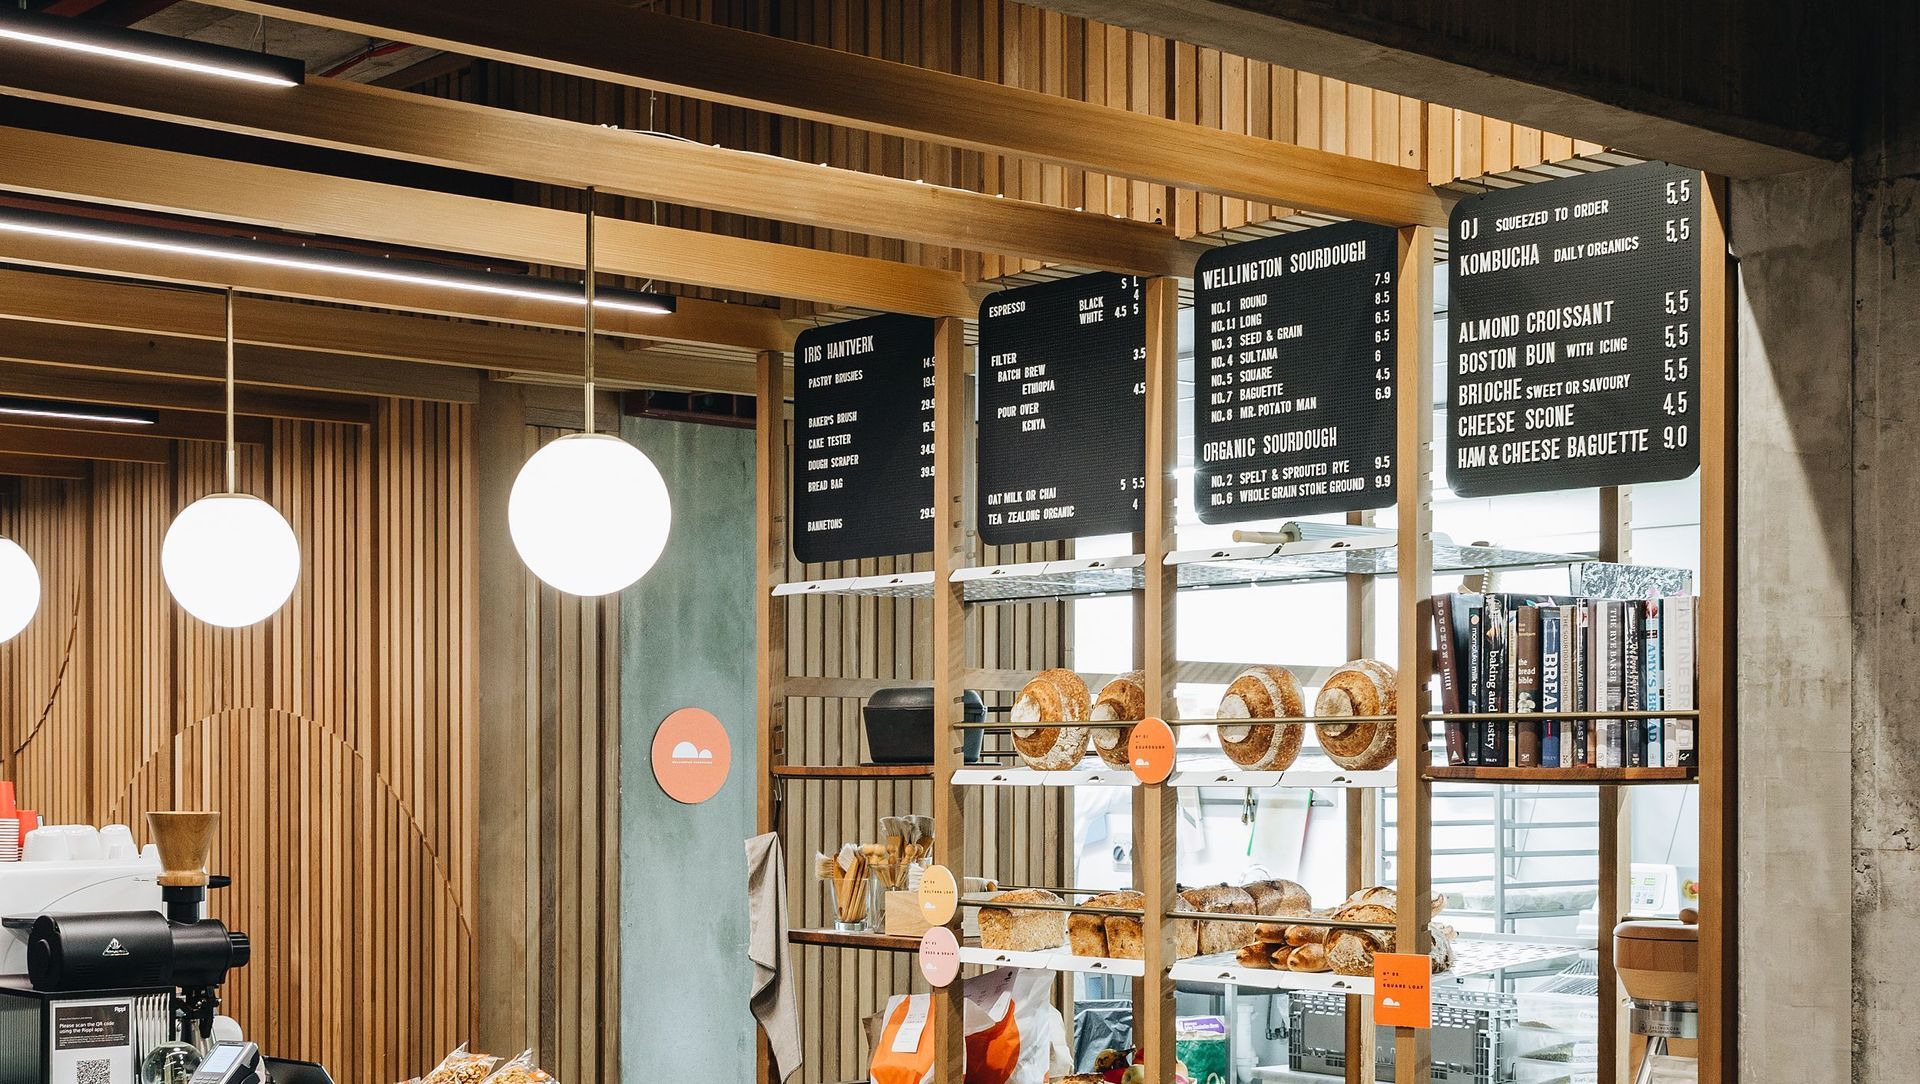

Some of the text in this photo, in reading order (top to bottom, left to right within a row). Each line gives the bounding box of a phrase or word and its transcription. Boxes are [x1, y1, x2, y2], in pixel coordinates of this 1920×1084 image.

[1496, 210, 1549, 232] SQUEEZED
[1554, 207, 1568, 222] TO
[1574, 199, 1609, 218] ORDER
[1666, 179, 1690, 205] 5.5
[1460, 217, 1689, 276] KOMBUCHA DAILY ORGANICS 5.5
[1203, 240, 1366, 290] WELLINGTON SOURDOUGH
[989, 275, 1139, 318] ESPRESSO S L
[1079, 289, 1139, 311] BLACK 4
[1240, 294, 1267, 310] ROUND
[1375, 271, 1390, 286] 7.9
[1079, 303, 1139, 325] WHITE 4.5 5
[1240, 313, 1262, 328] LONG
[1375, 291, 1390, 305] 8.5
[1459, 289, 1688, 343] ALMOND CROISSANT 5.5
[1240, 331, 1262, 346] SEED
[1266, 330, 1273, 342] &
[1277, 324, 1303, 340] GRAIN
[1375, 310, 1390, 324] 6.5
[804, 335, 874, 364] IRIS HANTVERK
[991, 352, 1017, 367] FILTER
[1240, 347, 1278, 364] SULTANA
[1375, 329, 1390, 343] 6.5
[1459, 323, 1688, 375] BOSTON BUN WITH ICING 5.5
[808, 375, 832, 388] PASTRY
[835, 369, 863, 384] BRUSHES
[998, 347, 1146, 382] BATCH BREW 3.5
[1240, 366, 1273, 383] SQUARE
[1375, 350, 1381, 362] 6
[1022, 380, 1055, 395] ETHIOPIA
[1240, 383, 1284, 401] BAGUETTE
[1375, 367, 1390, 381] 4.5
[1459, 357, 1688, 406] BRIOCHE SWEET OR SAVOURY 5.5
[997, 382, 1146, 419] POUR OVER 4.5
[1296, 396, 1317, 411] MAN
[1375, 386, 1391, 400] 6.9
[1458, 391, 1687, 437] CHEESE SCONE 4.5
[808, 415, 834, 428] BAKER'S
[837, 411, 857, 424] BRUSH
[1022, 418, 1046, 432] KENYA
[808, 437, 824, 449] CAKE
[827, 434, 851, 447] TESTER
[1203, 426, 1337, 462] ORGANIC SOURDOUGH
[1567, 428, 1649, 458] BAGUETTE
[1664, 425, 1687, 449] 9.0
[808, 458, 828, 471] DOUGH
[831, 454, 859, 468] SCRAPER
[1240, 469, 1267, 485] SPELT
[1271, 468, 1279, 481] &
[1282, 463, 1327, 480] SPROUTED
[1332, 460, 1349, 474] RYE
[1375, 455, 1390, 469] 9.5
[808, 480, 828, 492] BREAD
[830, 478, 843, 489] BAG
[988, 477, 1145, 505] OAT MILK OR CHAI 5 5.5
[1239, 487, 1270, 503] WHOLE
[1271, 485, 1297, 499] GRAIN
[1299, 481, 1327, 496] STONE
[1329, 477, 1365, 493] GROUND
[1375, 474, 1391, 488] 9.9
[807, 518, 843, 532] BANNETONS
[988, 498, 1138, 525] TEA ZEALONG ORGANIC 4
[1471, 627, 1479, 665] momofuku
[1609, 608, 1617, 682] THE RYE BAKER
[1471, 666, 1479, 682] milk
[1518, 658, 1528, 666] the
[1518, 667, 1536, 675] bread
[1471, 683, 1479, 696] bar
[1518, 676, 1534, 684] bible
[1543, 652, 1558, 714] BREA
[1648, 643, 1657, 742] AMY'S BRAD
[1485, 650, 1499, 750] baking and astry
